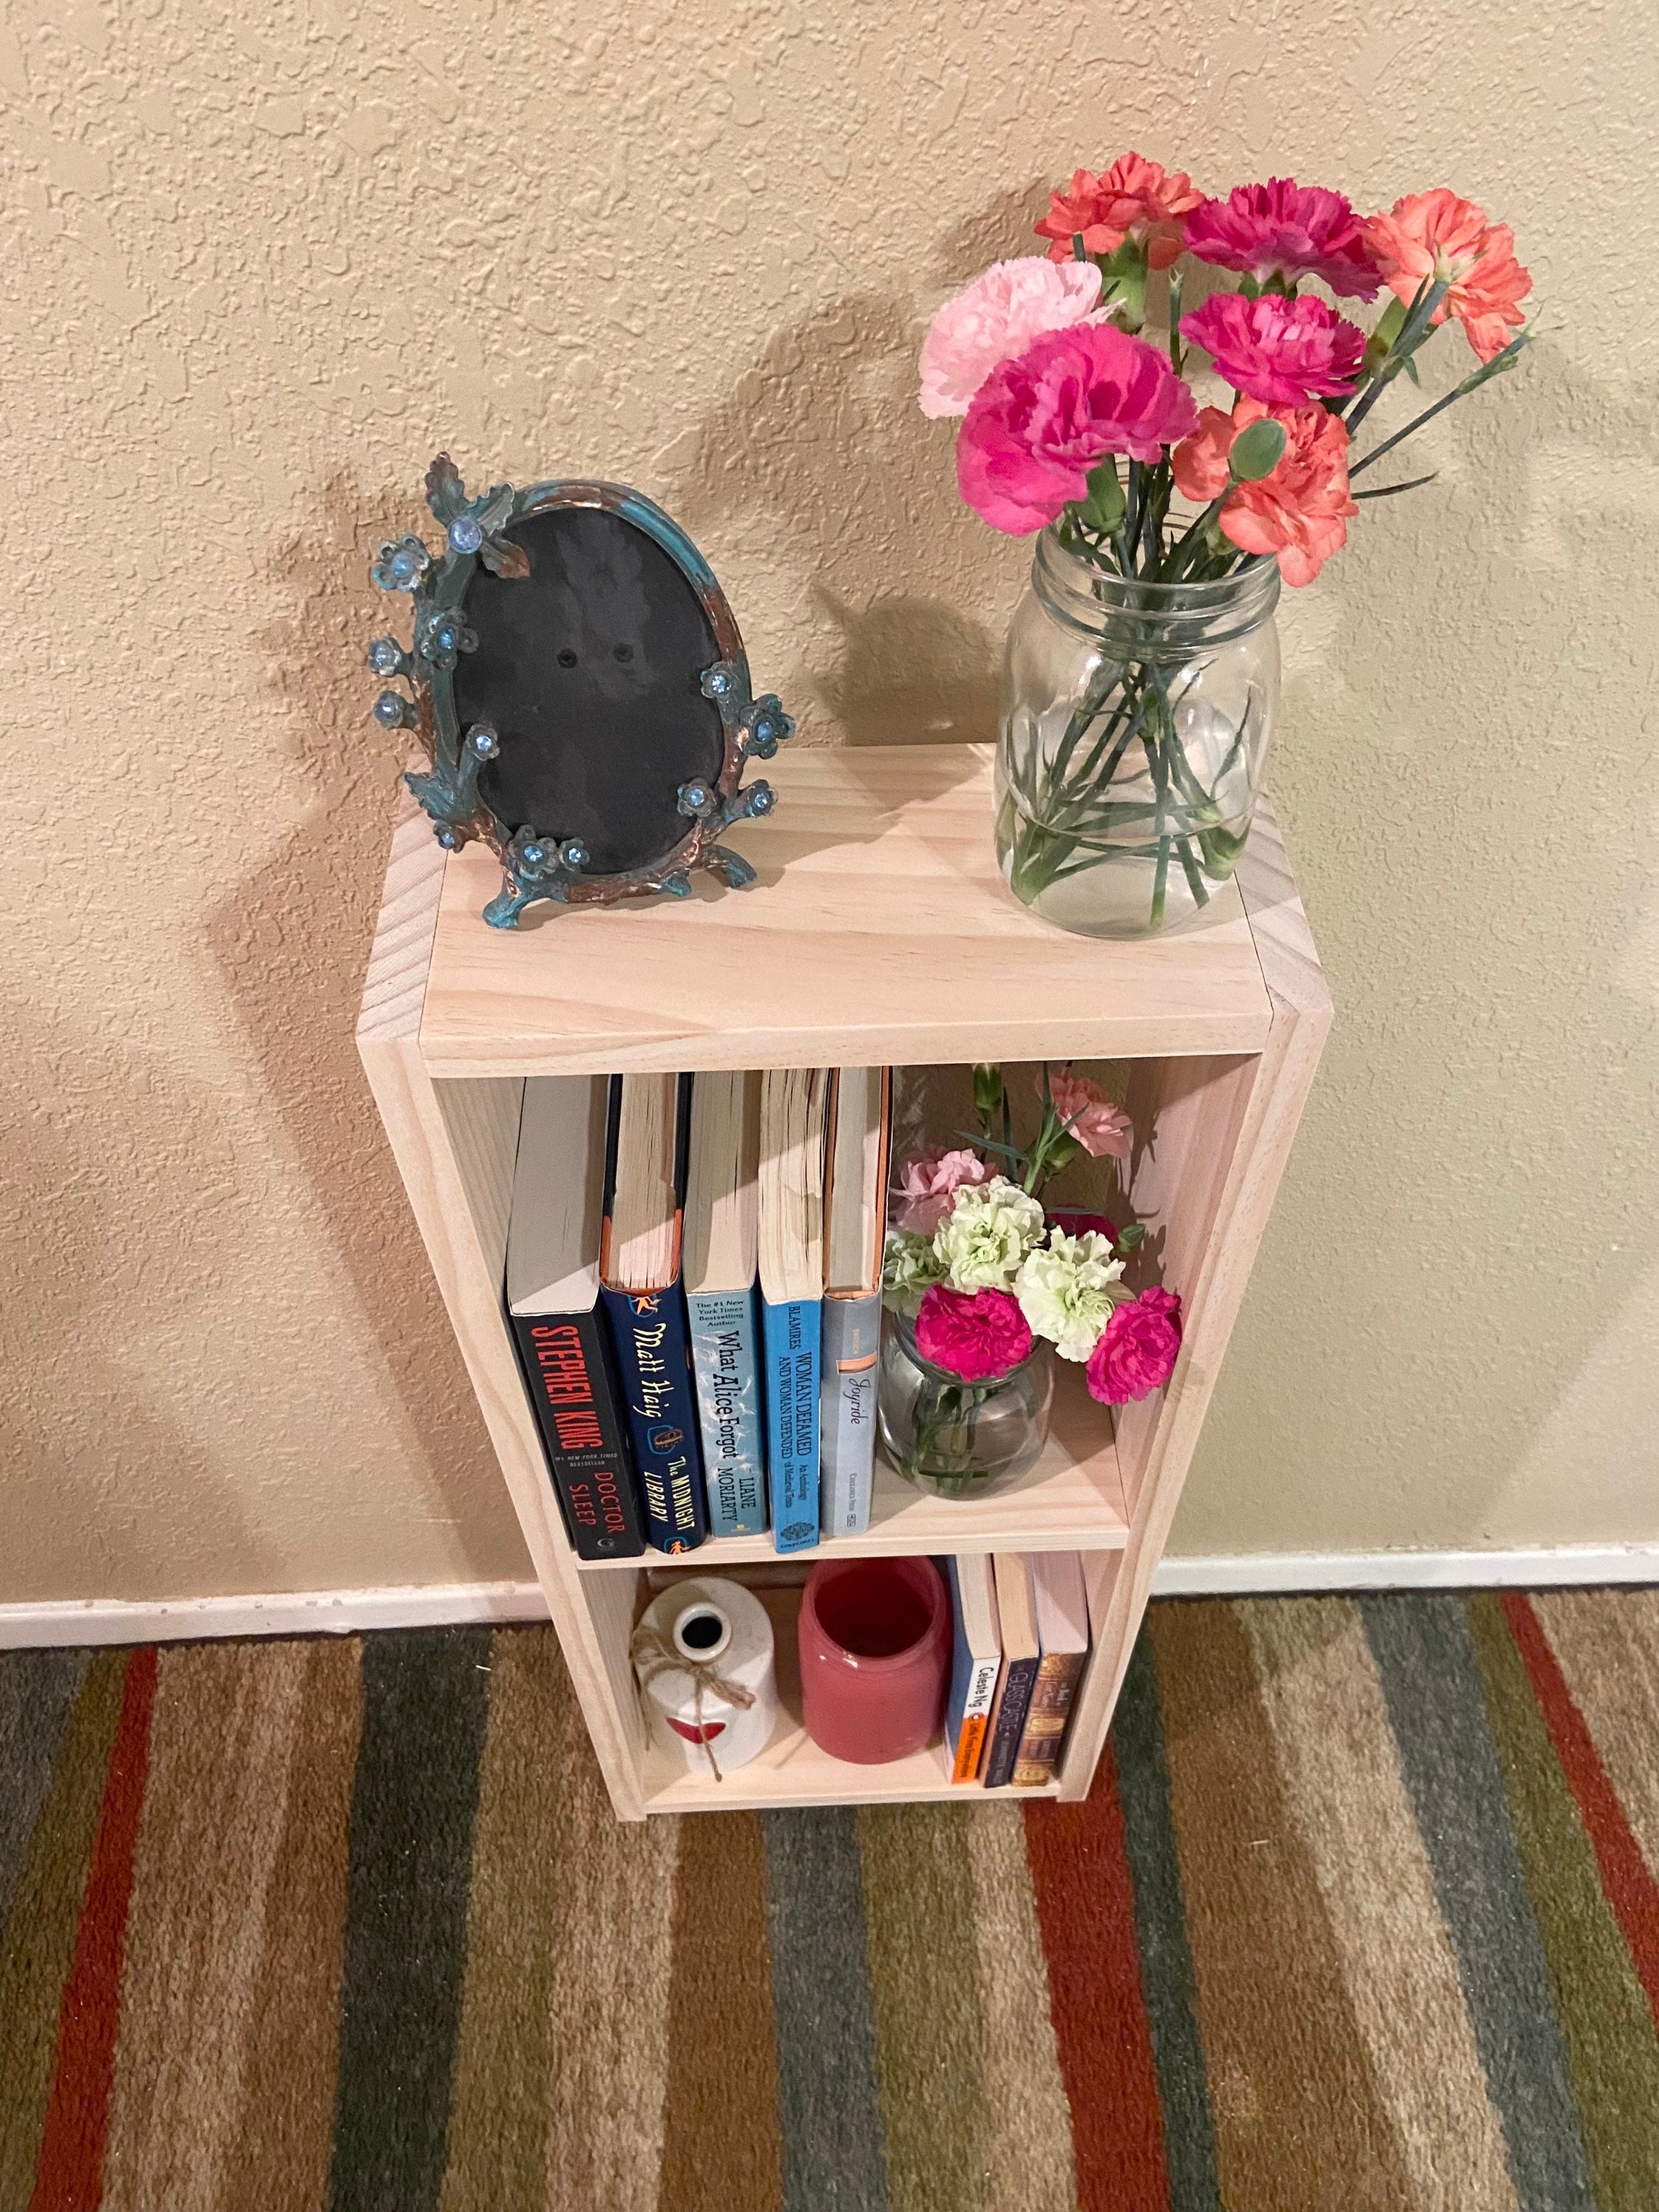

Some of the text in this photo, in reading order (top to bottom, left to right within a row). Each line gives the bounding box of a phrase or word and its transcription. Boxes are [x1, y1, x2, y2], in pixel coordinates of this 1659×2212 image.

[699, 1313, 744, 1321] Bestselling
[788, 1306, 801, 1350] BLAMIRES
[532, 1324, 604, 1451] STEPHEN KING
[633, 1322, 674, 1418] Matt Haig
[778, 1357, 792, 1376] AND
[795, 1351, 812, 1404] WOMAN
[713, 1331, 743, 1459] What Alice Forgot
[779, 1377, 793, 1414] WOMAN
[843, 1378, 871, 1425] Joyride
[781, 1414, 793, 1459] DEFENDED
[795, 1405, 812, 1456] DEFAMED
[569, 1483, 597, 1525] SLEEP
[594, 1471, 625, 1533] DOCTOR
[644, 1471, 669, 1522] LIBRARY
[667, 1456, 695, 1530] The MIDNIGHT
[717, 1468, 738, 1521] MORIARTY
[739, 1477, 756, 1509] LIANE
[968, 1694, 988, 1708] Ng
[974, 1666, 994, 1694] Celeste
[1005, 1672, 1028, 1701] GLASS
[999, 1701, 1023, 1731] CASTLE
